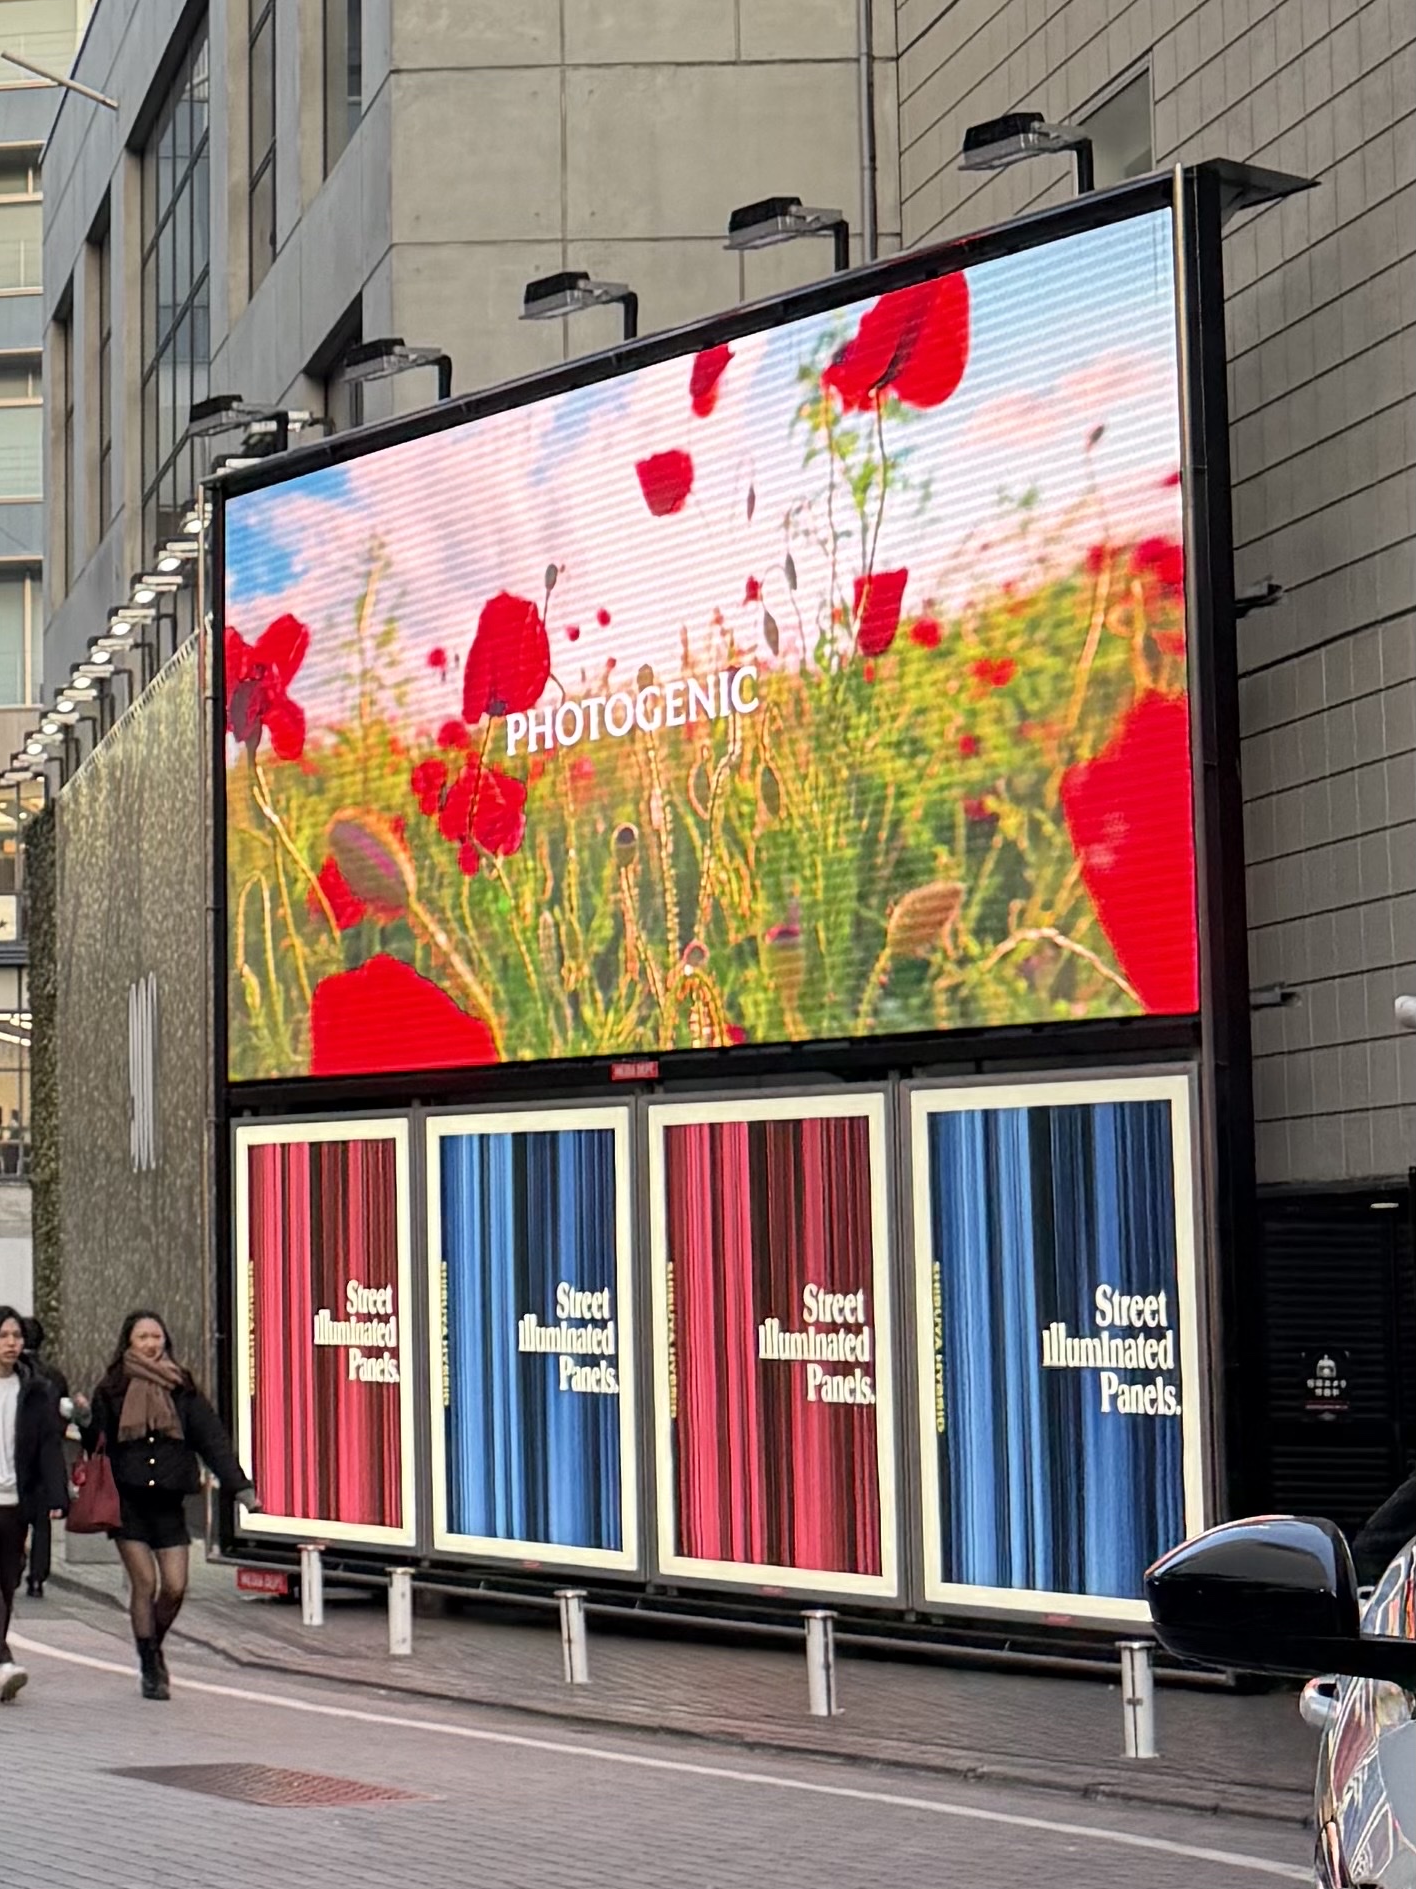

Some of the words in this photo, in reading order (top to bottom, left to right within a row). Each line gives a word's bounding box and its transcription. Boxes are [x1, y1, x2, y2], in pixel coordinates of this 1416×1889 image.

[506, 665, 759, 757] PHOTOGENIC
[346, 1280, 393, 1315] Street
[556, 1282, 609, 1320] Street
[802, 1284, 864, 1324] Street
[1095, 1284, 1168, 1327] Street
[349, 1348, 400, 1383] Panels.
[560, 1355, 619, 1394] Panels.
[807, 1363, 876, 1404] Panels.
[1101, 1372, 1182, 1415] Panels.
